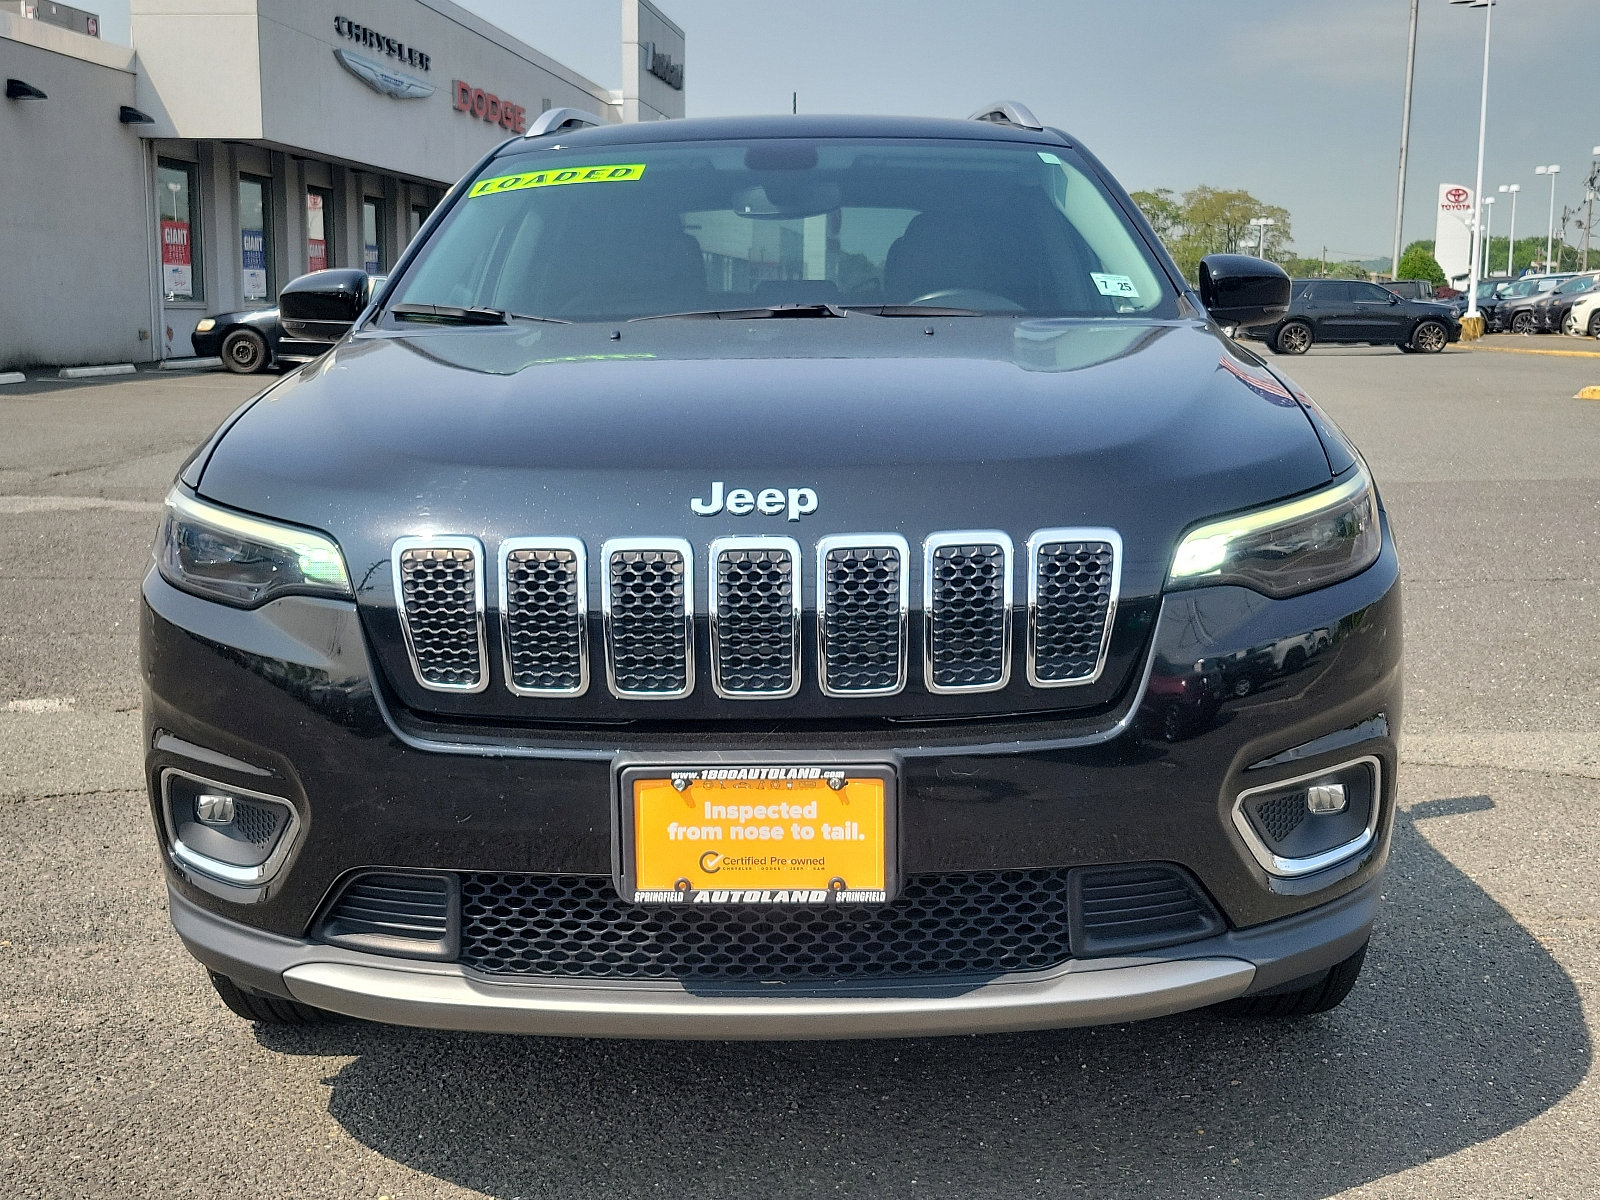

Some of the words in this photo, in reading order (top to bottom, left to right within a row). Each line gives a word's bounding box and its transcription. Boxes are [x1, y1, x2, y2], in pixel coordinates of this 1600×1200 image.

[333, 15, 432, 71] CHRYSLER
[452, 80, 526, 133] DODGE
[477, 168, 634, 193] LOADED
[165, 228, 187, 245] GIANT
[244, 236, 262, 252] GIANT
[1100, 280, 1108, 289] 7
[1117, 282, 1132, 291] 25
[690, 481, 819, 522] Jeep
[671, 768, 845, 781] www.1800AUTOLAND.com
[704, 801, 817, 823] Inspected
[667, 822, 723, 840] from
[730, 825, 785, 840] nose
[790, 823, 815, 840] to
[821, 822, 865, 840] tail.
[722, 856, 767, 866] Certified
[634, 892, 684, 903] SPRINGFIELD
[693, 891, 828, 904] AUTOLAND
[836, 892, 886, 903] SPRINGFIELD
